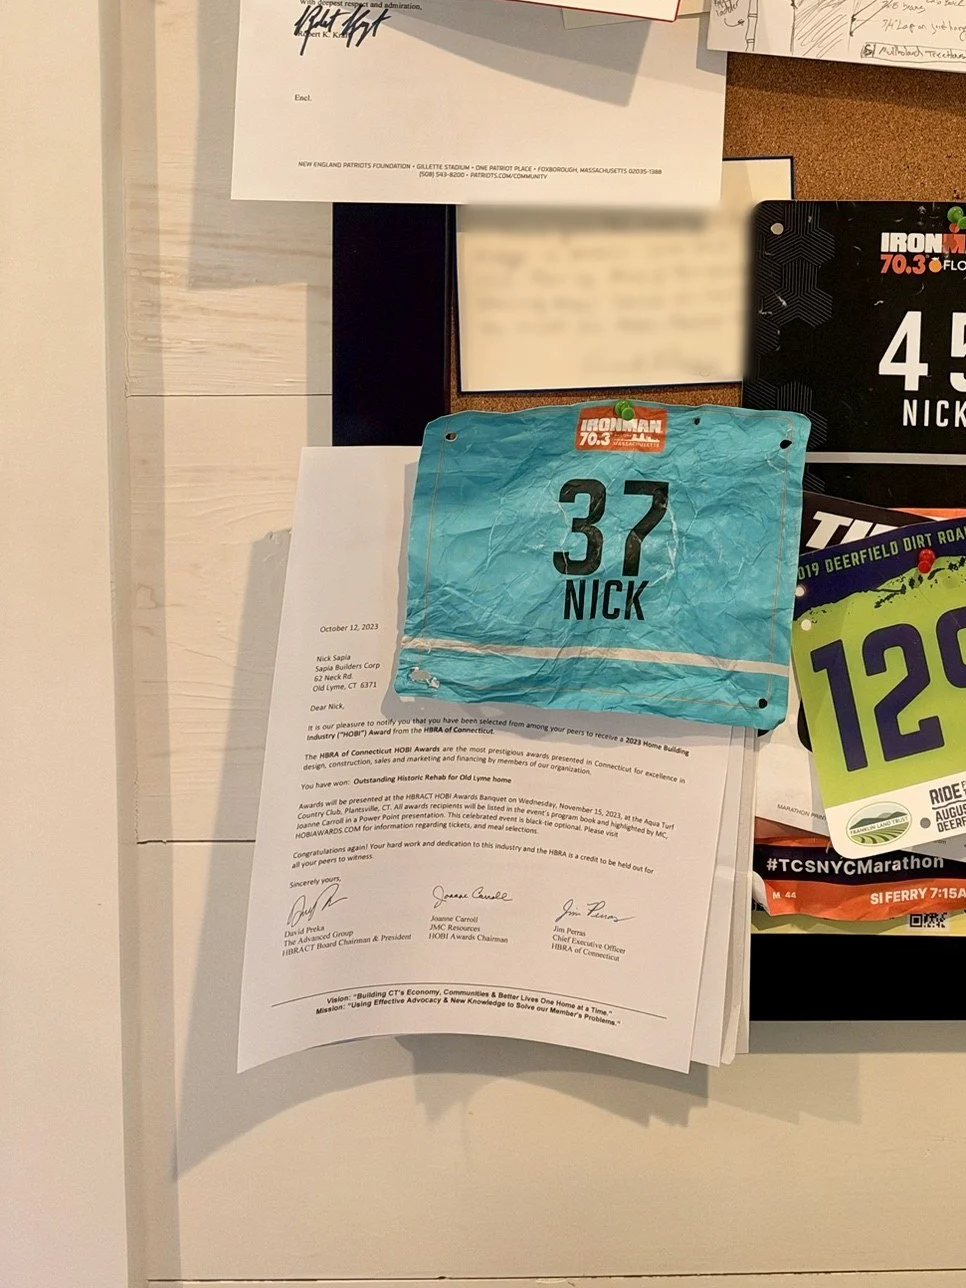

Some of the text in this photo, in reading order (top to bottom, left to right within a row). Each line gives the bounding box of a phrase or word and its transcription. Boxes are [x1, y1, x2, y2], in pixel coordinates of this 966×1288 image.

[880, 254, 926, 274] 70.3
[581, 418, 662, 433] IRONMAN
[580, 432, 611, 446] 70.3
[553, 479, 669, 577] 37
[799, 564, 820, 581] 019
[826, 541, 899, 573] DEERFIELD
[903, 534, 932, 552] DIRT
[563, 579, 650, 621] NICK
[320, 625, 348, 633] October
[333, 654, 351, 662] Sapia
[328, 702, 345, 711] Nick,
[353, 775, 395, 785] Outstanding
[397, 774, 423, 782] Historic
[929, 782, 963, 806] RIDE
[777, 803, 810, 817] MARATHON
[849, 816, 909, 835] FRANKLIN LAND TRUST
[766, 855, 944, 875] #TCSNYCMarathon
[885, 888, 928, 902] FERRY
[431, 915, 478, 923] Joanne Carroll
